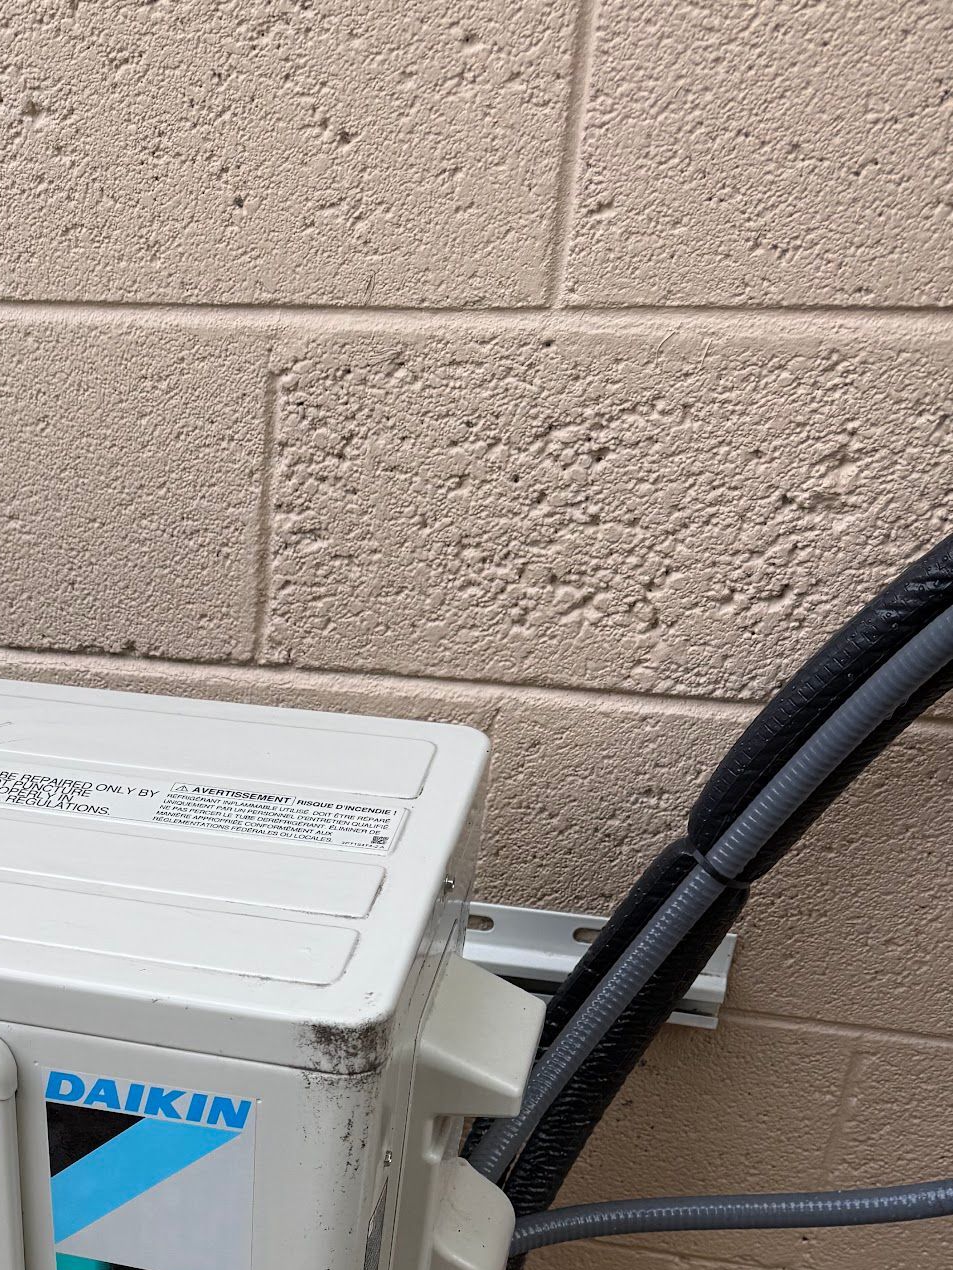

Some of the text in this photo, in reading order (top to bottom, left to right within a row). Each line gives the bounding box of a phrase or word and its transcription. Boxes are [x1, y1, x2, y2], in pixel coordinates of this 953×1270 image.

[13, 781, 94, 797] PUNCTURE
[20, 774, 93, 789] REPAIRED
[96, 784, 137, 795] ONLY
[138, 790, 161, 798] BY
[6, 795, 111, 815] REGULATIONS.
[57, 795, 74, 803] IN
[163, 799, 215, 809] UNIQUEMENT
[247, 809, 295, 819] PERSONNEL
[192, 787, 291, 804] AVERTISSEMENT
[296, 800, 334, 809] RISQUE
[336, 804, 391, 815] D'INCENDIE
[45, 1070, 252, 1130] DAIKIN
